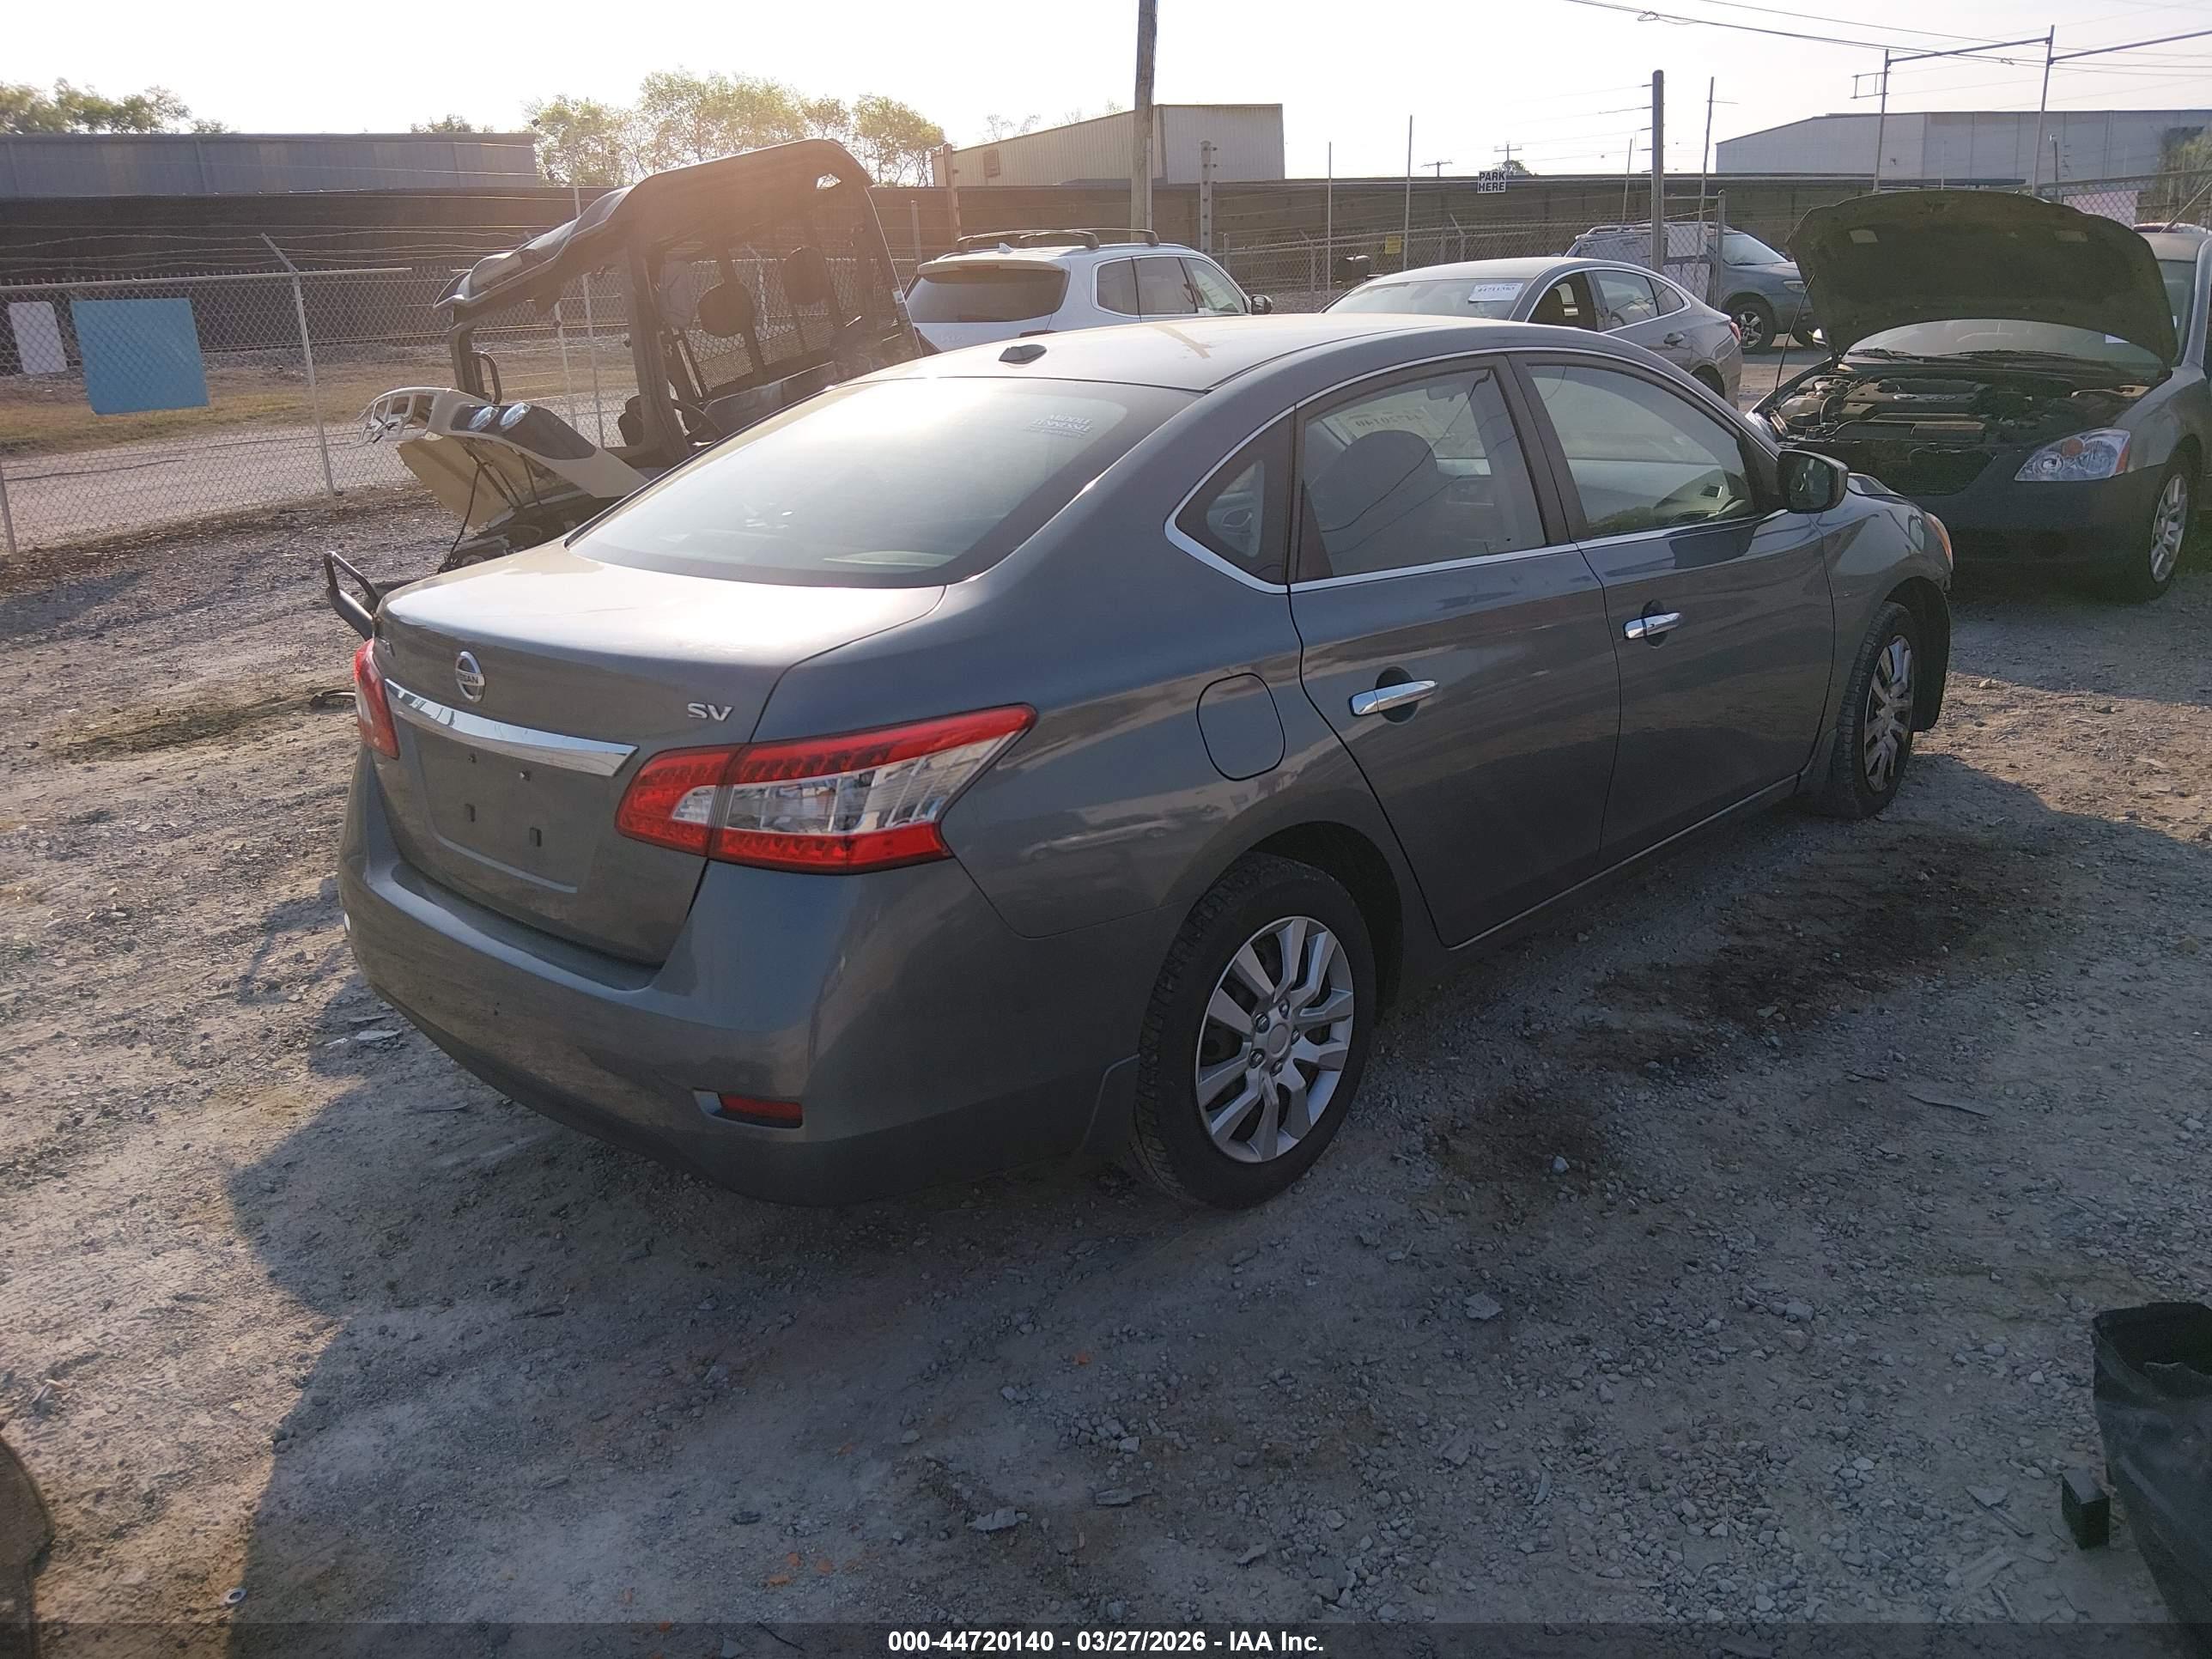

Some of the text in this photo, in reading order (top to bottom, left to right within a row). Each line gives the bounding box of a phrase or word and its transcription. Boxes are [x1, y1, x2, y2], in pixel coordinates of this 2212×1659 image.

[1479, 172, 1505, 181] PARK
[1478, 182, 1505, 191] HERE
[687, 702, 733, 721] SV
